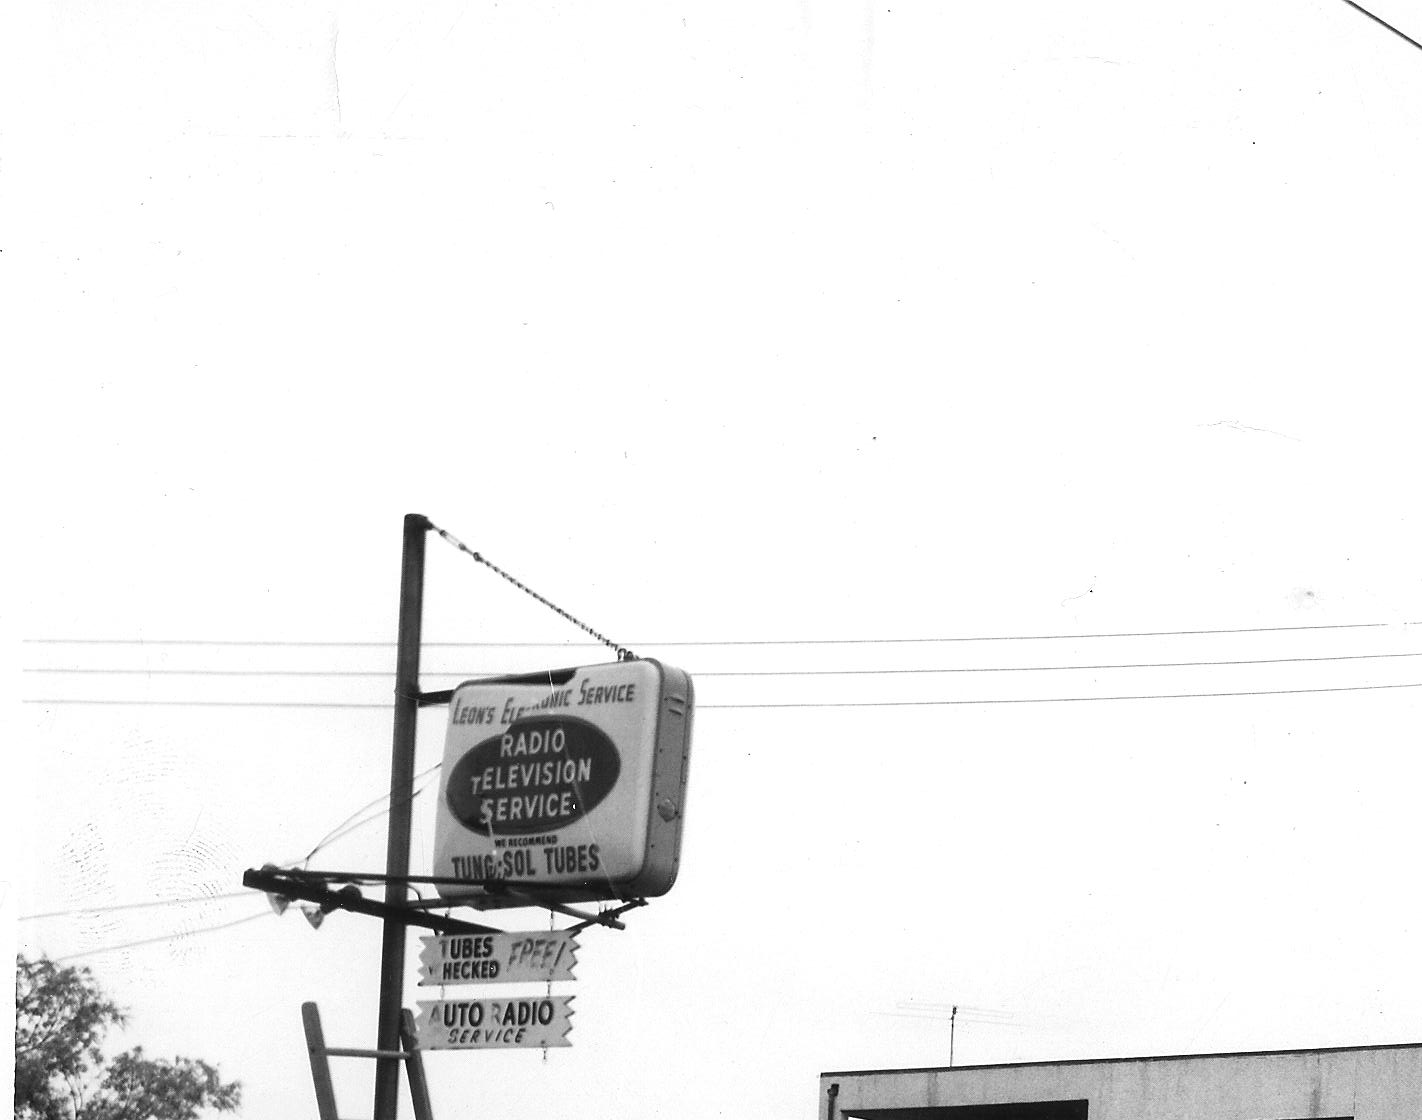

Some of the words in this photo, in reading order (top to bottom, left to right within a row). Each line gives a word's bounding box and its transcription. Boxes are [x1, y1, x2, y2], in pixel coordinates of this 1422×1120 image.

[452, 696, 497, 725] LEON'S
[577, 678, 636, 705] SERVICE
[501, 728, 566, 758] RADIO
[470, 757, 593, 795] TELEVISION
[479, 791, 572, 824] SERVICE
[494, 838, 507, 848] WE
[508, 834, 558, 848] RECOMMEND
[543, 843, 601, 875] TUBES
[439, 936, 494, 960] TUBES
[429, 960, 500, 980] HECKED
[428, 1002, 484, 1027] AUTO
[491, 1000, 555, 1026] RADIO
[447, 1028, 527, 1044] SERVICE
